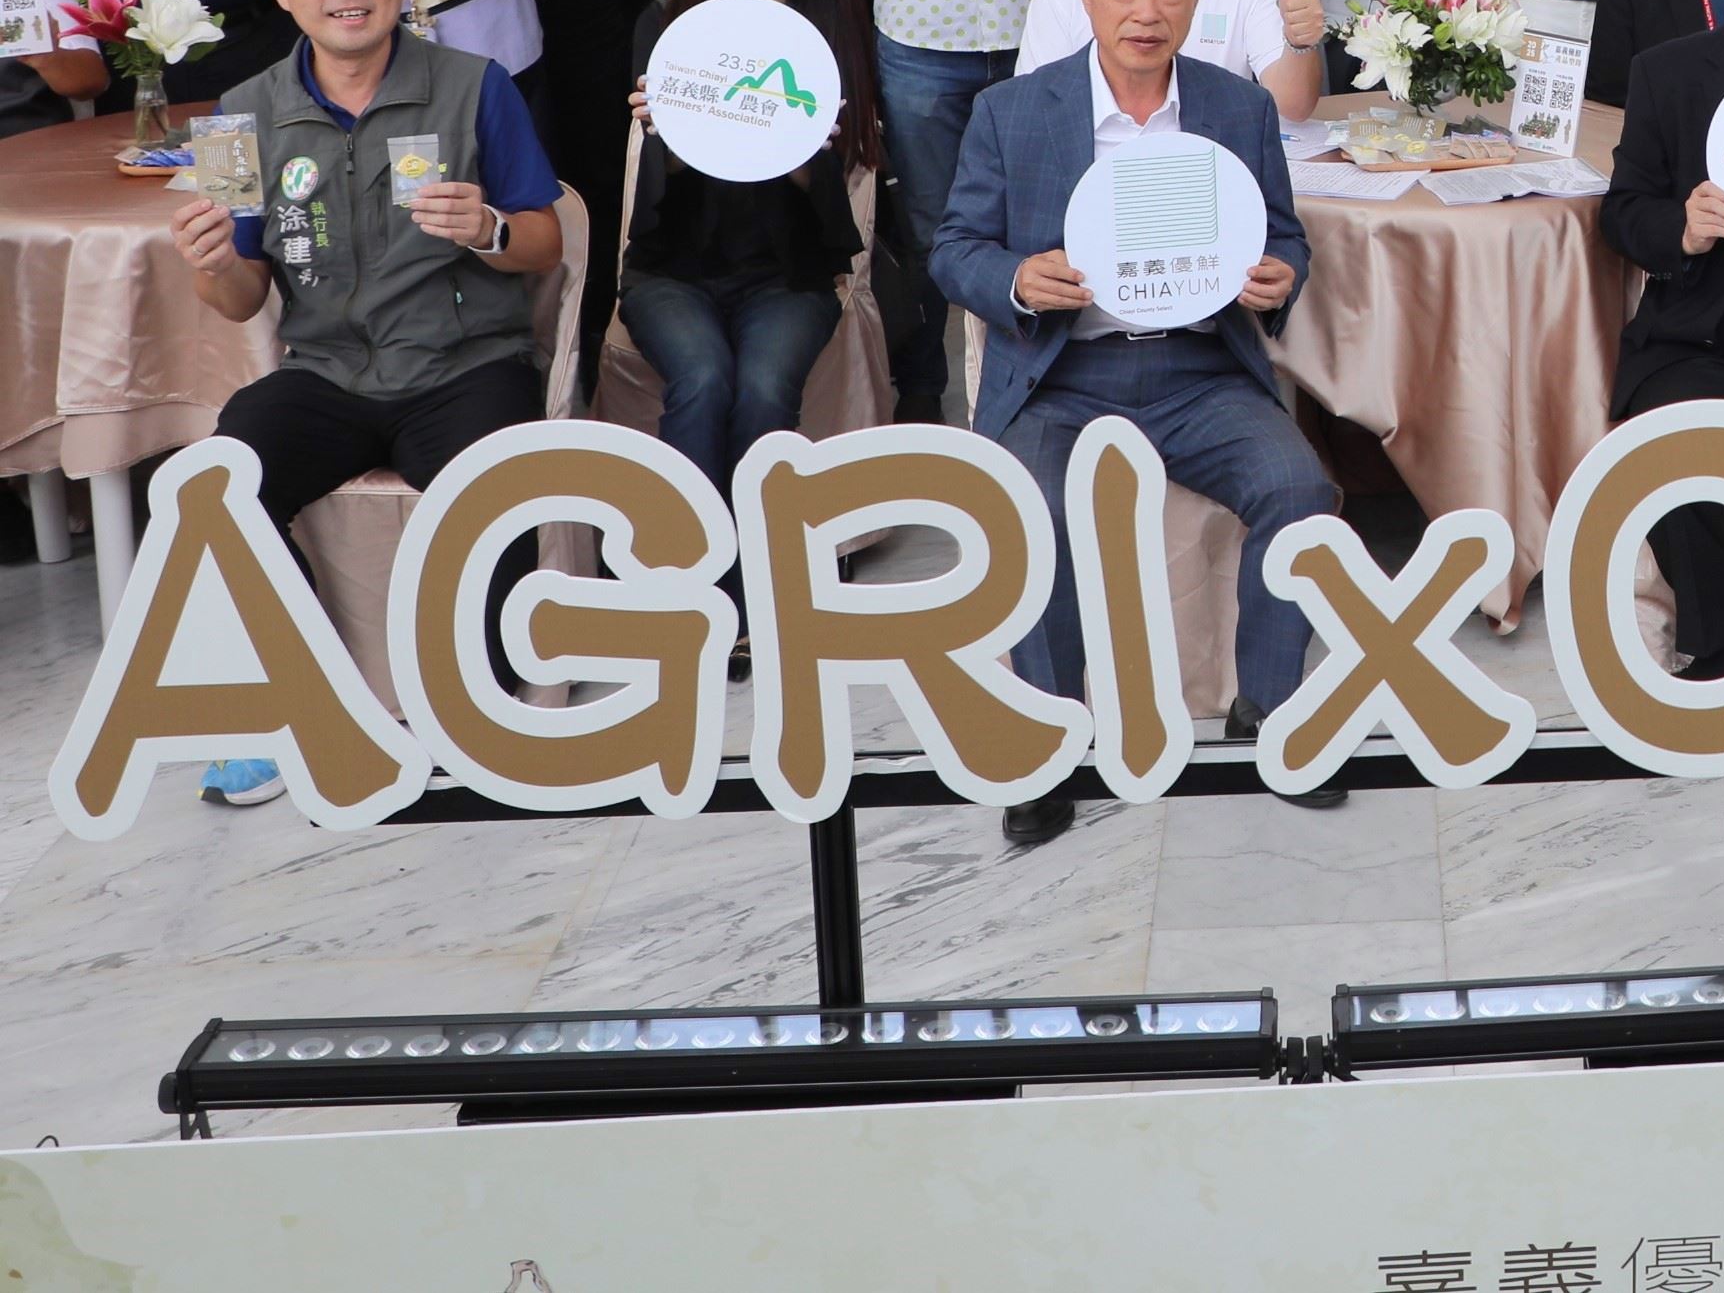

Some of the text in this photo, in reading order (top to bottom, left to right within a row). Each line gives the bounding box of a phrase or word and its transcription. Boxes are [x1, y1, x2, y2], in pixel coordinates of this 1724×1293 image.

[664, 60, 728, 84] Taiwan Chiayi
[656, 93, 771, 129] Farmers' Association
[659, 76, 779, 118] 嘉義縣 農會
[310, 201, 330, 248] 執行長
[1116, 253, 1220, 279] 嘉義優鮮
[1118, 276, 1220, 302] CHIAYUM
[50, 417, 1185, 841] AGRI
